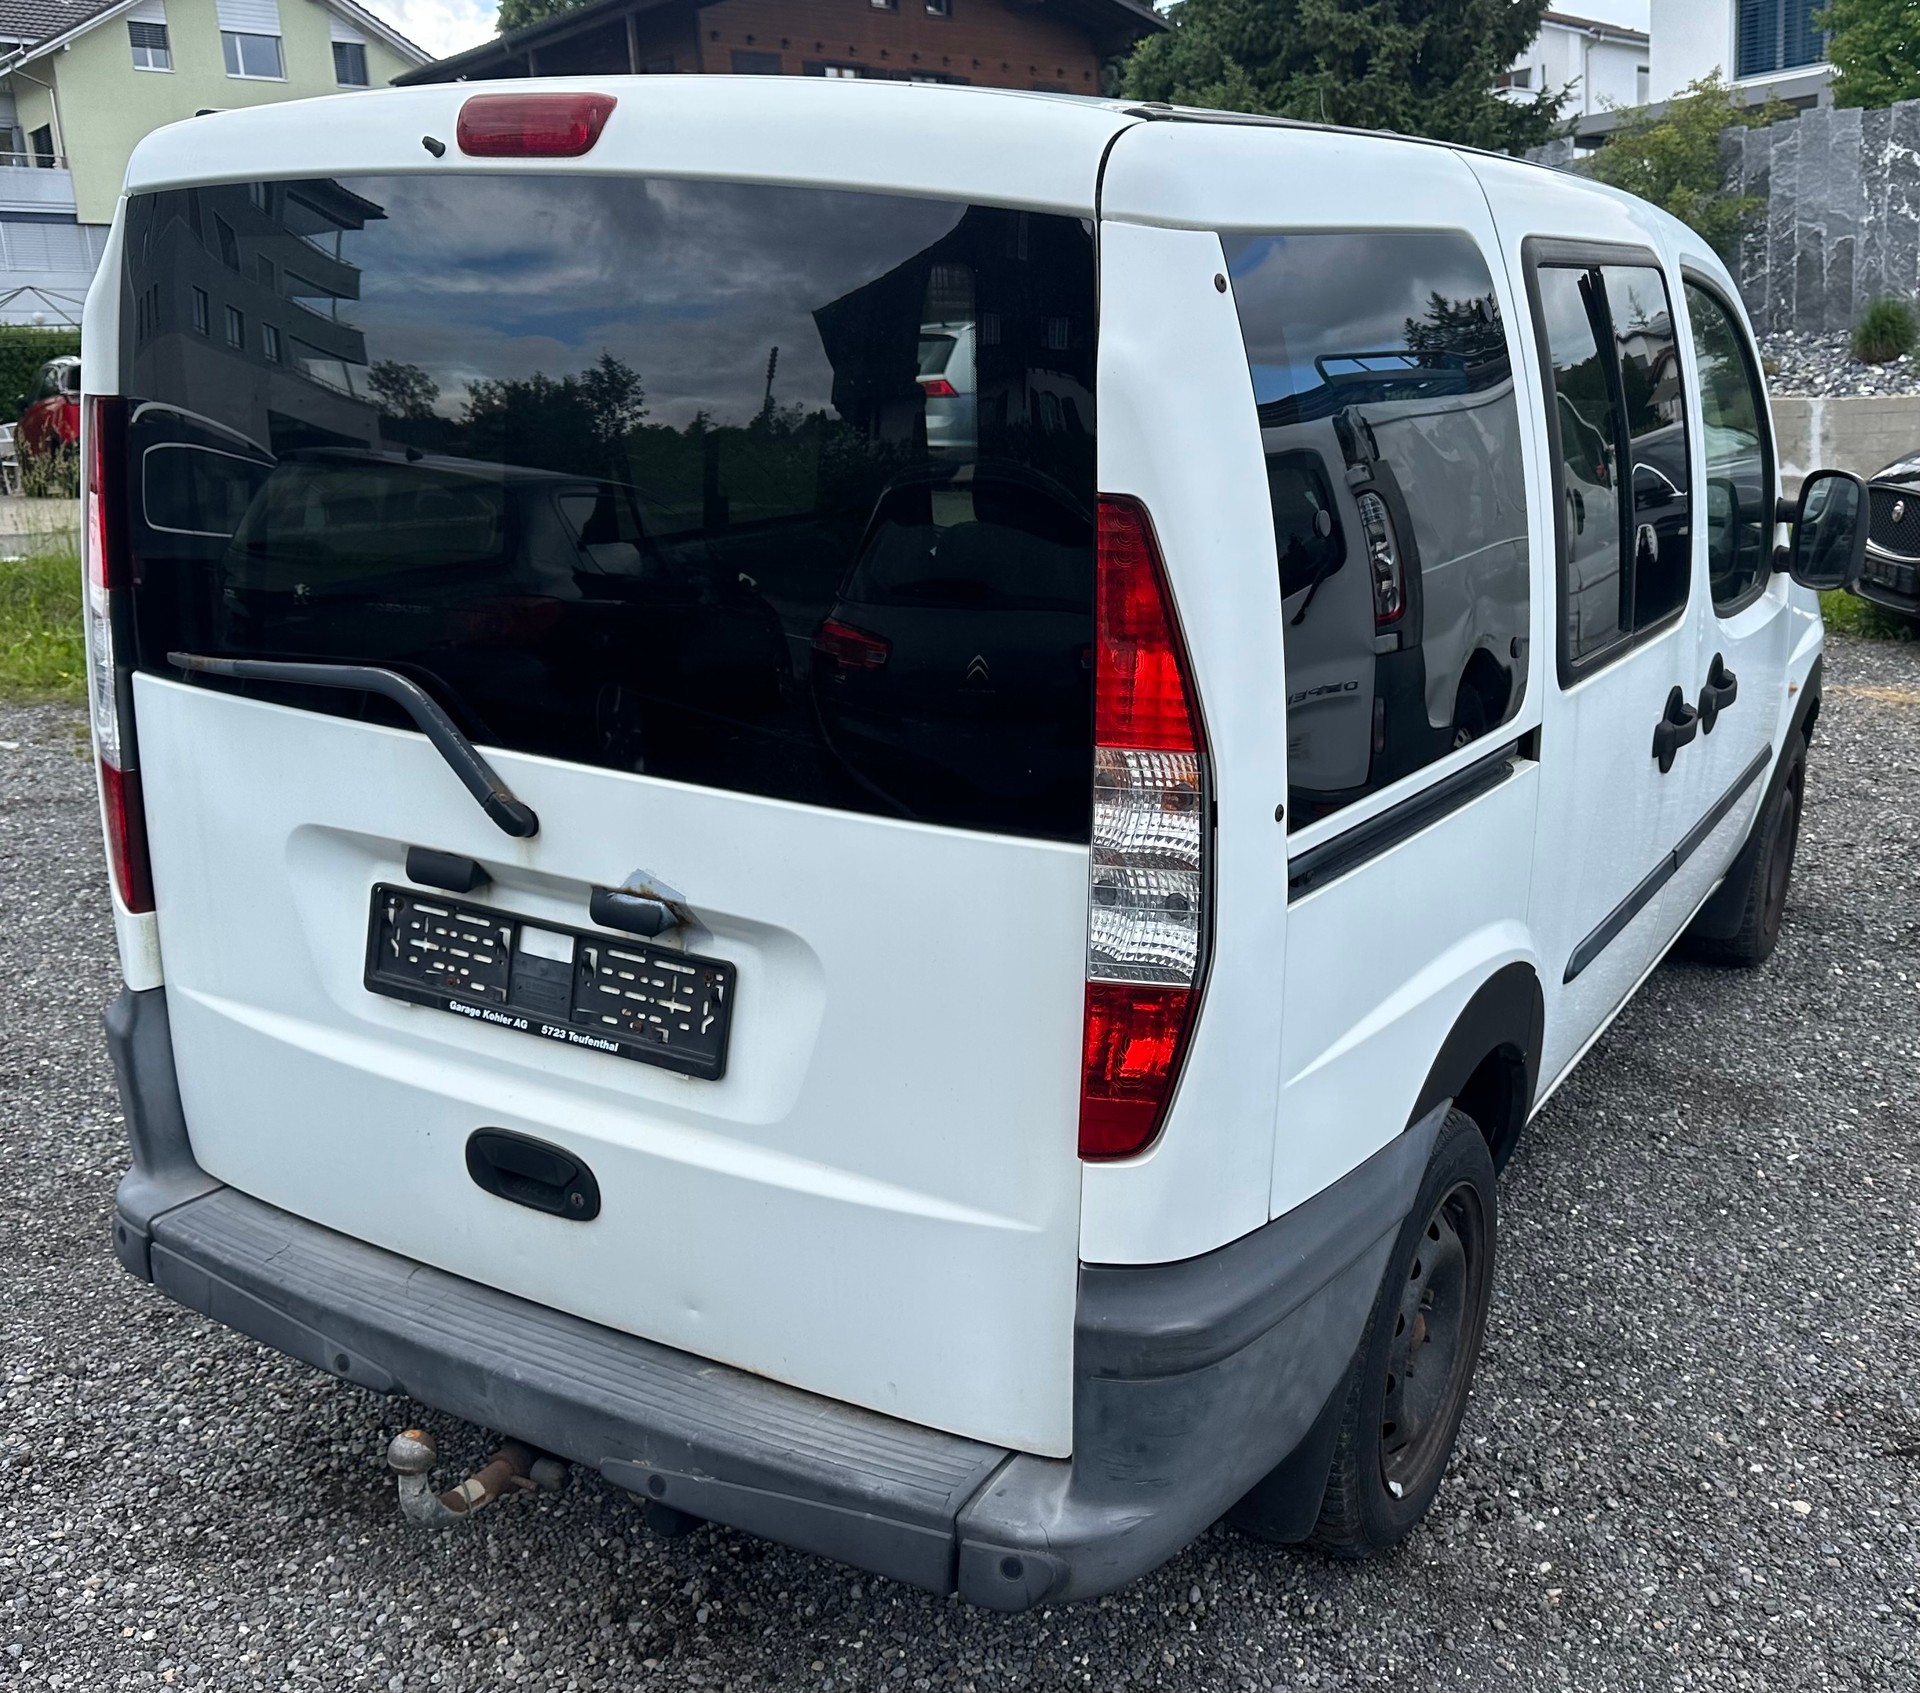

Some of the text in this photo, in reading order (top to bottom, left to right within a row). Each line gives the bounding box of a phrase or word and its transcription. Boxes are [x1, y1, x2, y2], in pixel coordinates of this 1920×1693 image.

[449, 1000, 619, 1052] Garage Kohler AG 5723 Teufenthal
